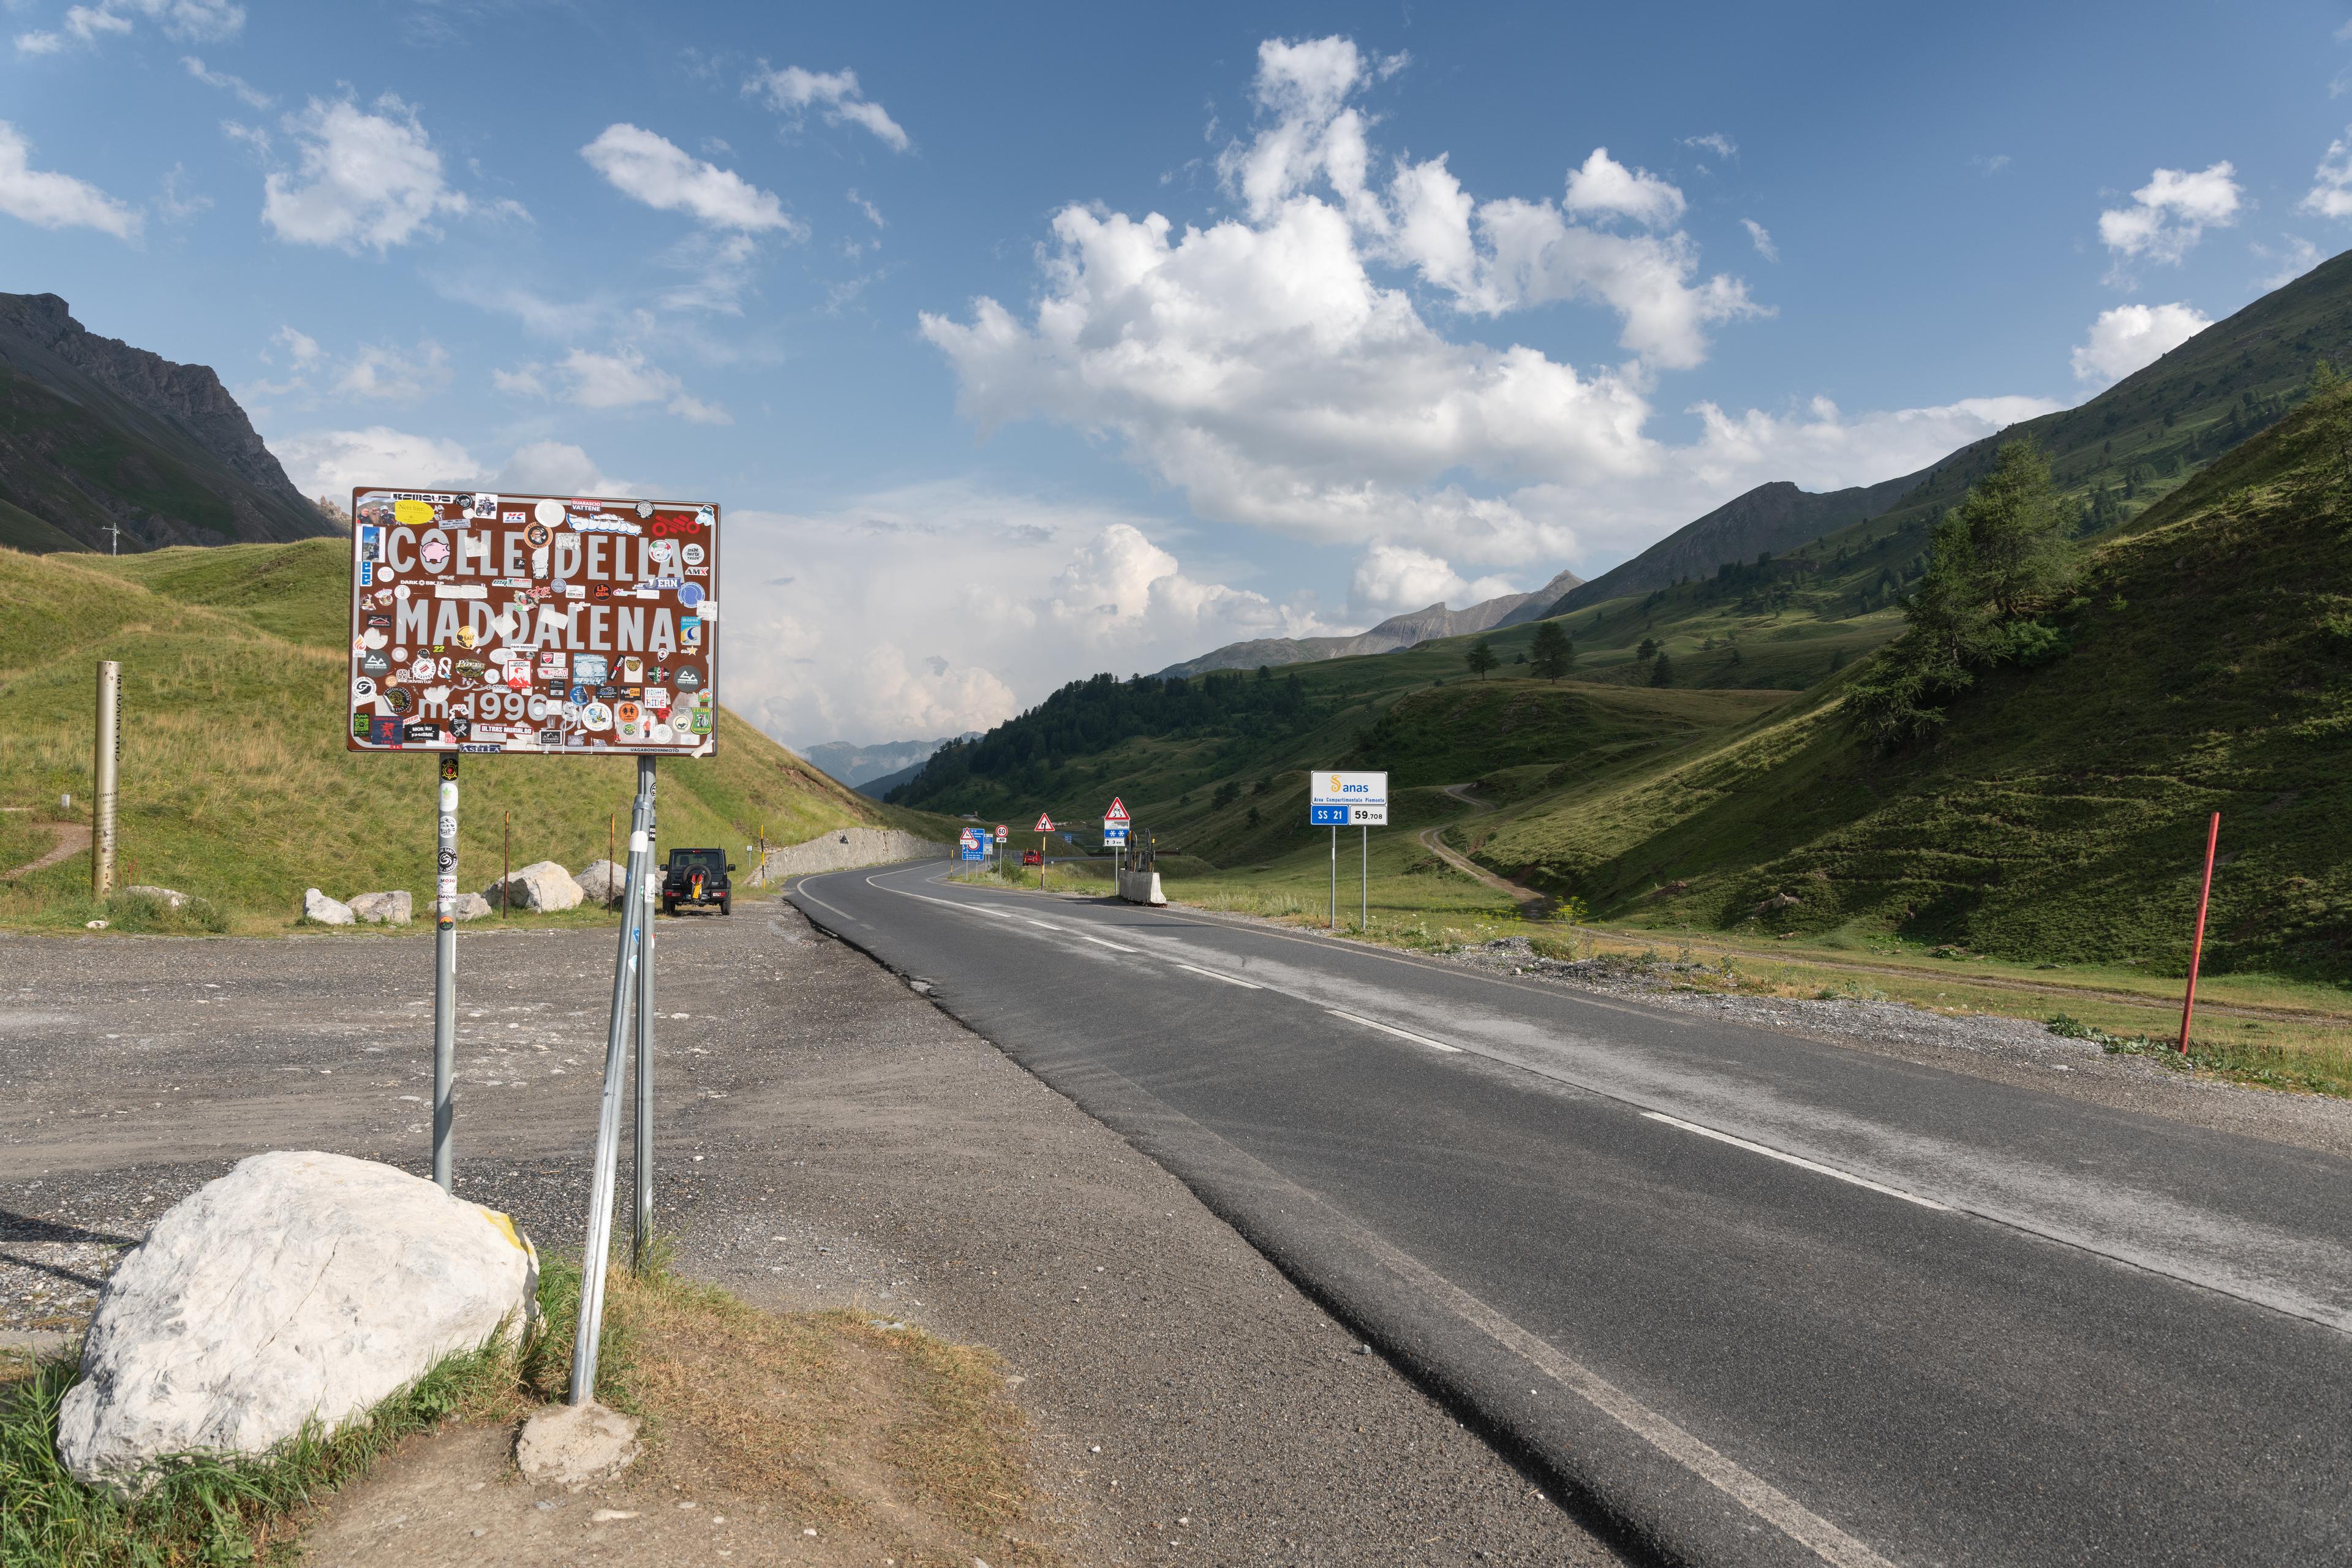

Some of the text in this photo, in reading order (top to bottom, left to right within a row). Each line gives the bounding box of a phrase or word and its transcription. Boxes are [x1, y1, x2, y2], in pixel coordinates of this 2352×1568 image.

[387, 527, 685, 583] COLLE DELLA
[396, 598, 677, 652] MADDALENA
[464, 692, 549, 721] 1996
[1318, 810, 1341, 820] SS 21
